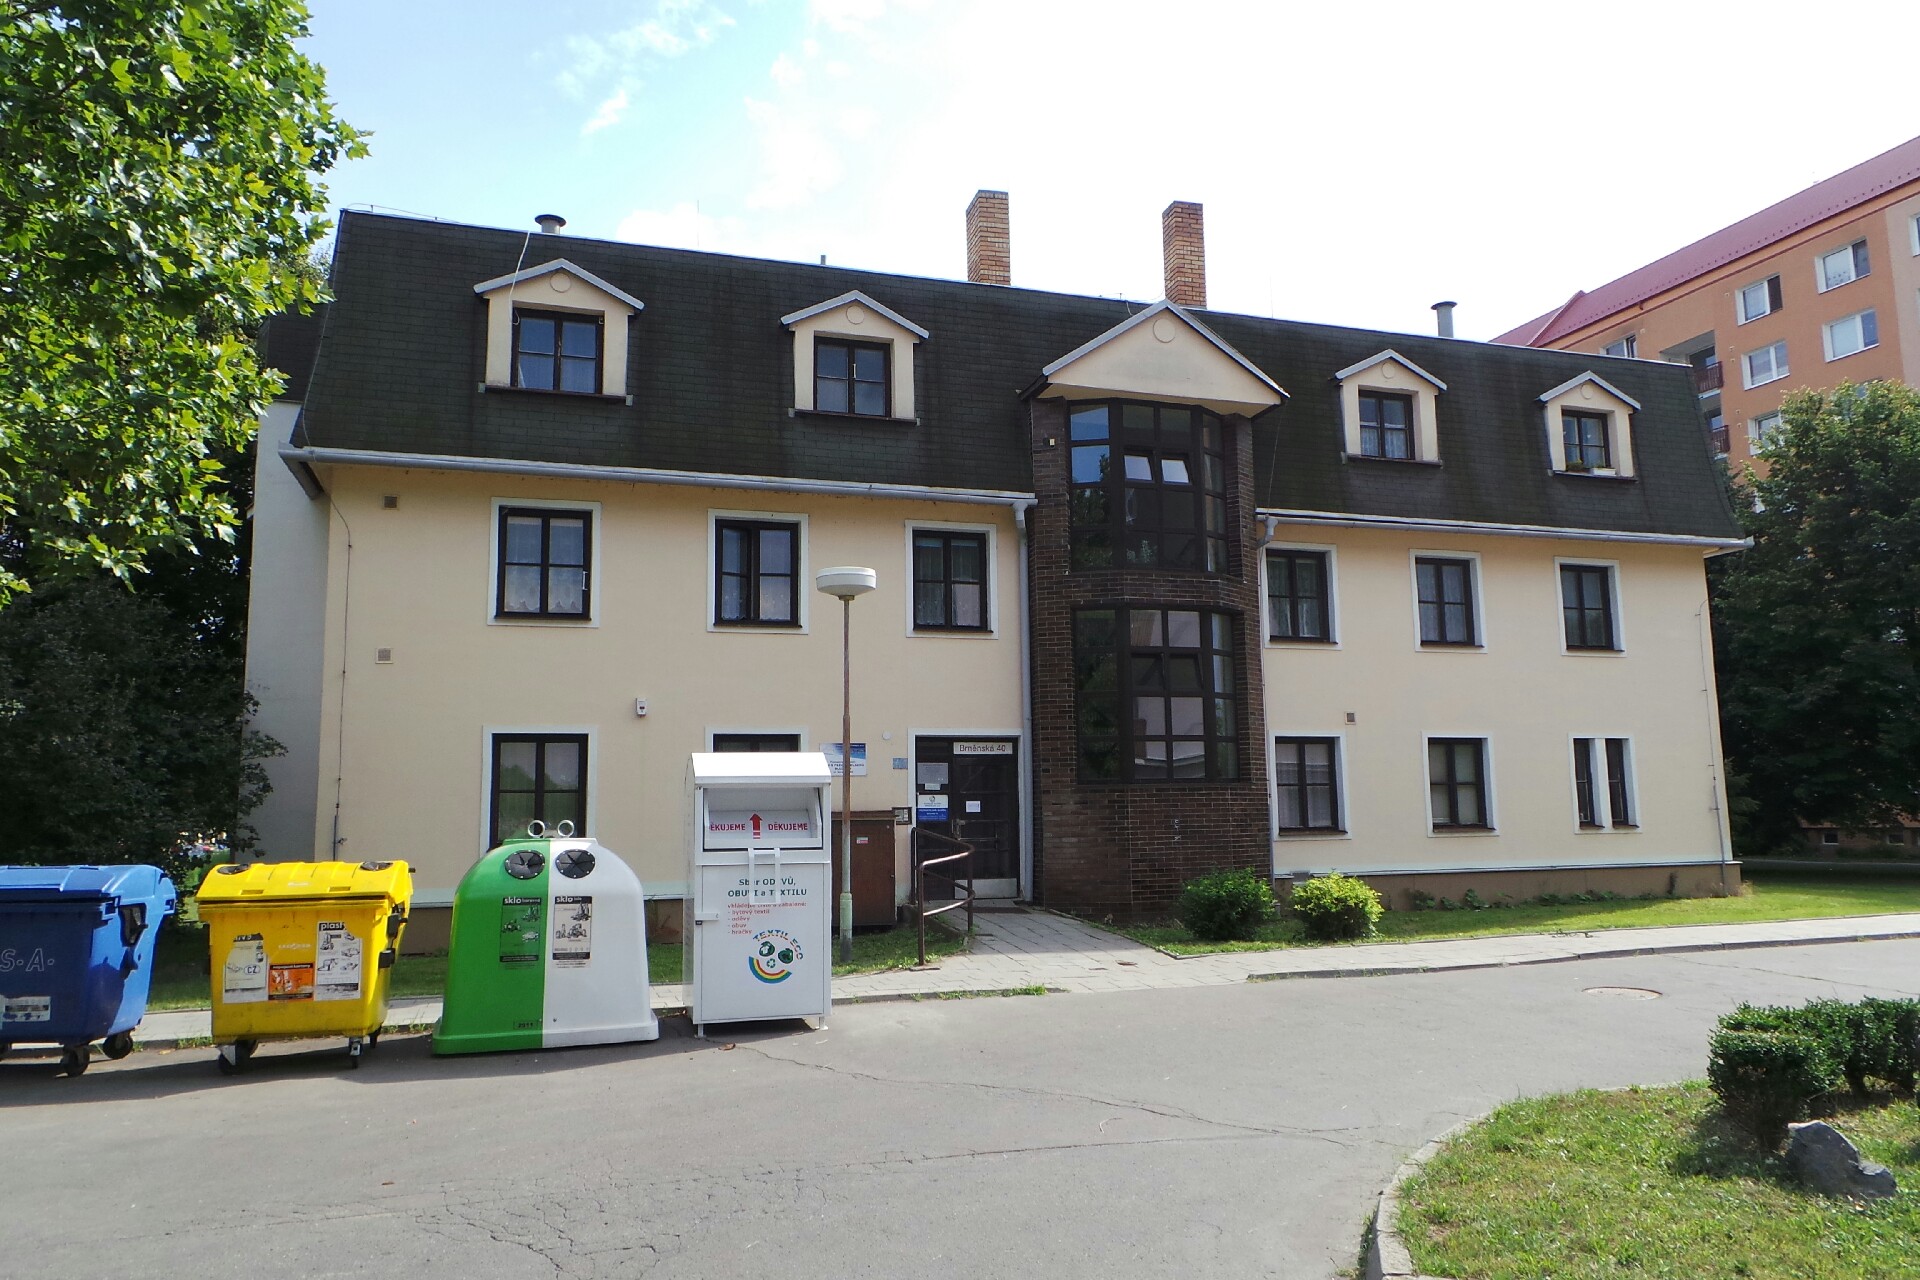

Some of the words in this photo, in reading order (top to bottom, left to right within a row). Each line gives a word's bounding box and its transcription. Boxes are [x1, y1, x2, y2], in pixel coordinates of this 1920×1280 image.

[959, 744, 995, 752] Brněnská
[996, 744, 1006, 752] 40
[709, 821, 746, 831] ĚKUJEME
[767, 821, 808, 831] DĚKUJEME
[738, 877, 760, 886] Sbr
[762, 876, 796, 886] ODVŮ,
[727, 889, 759, 897] OBUI
[769, 888, 807, 897] TXTILU
[504, 896, 522, 904] sklo
[556, 895, 574, 903] sklo
[320, 922, 346, 931] plast
[752, 929, 789, 942] TEXTIL
[789, 938, 804, 960] ECO
[247, 965, 257, 974] CZ
